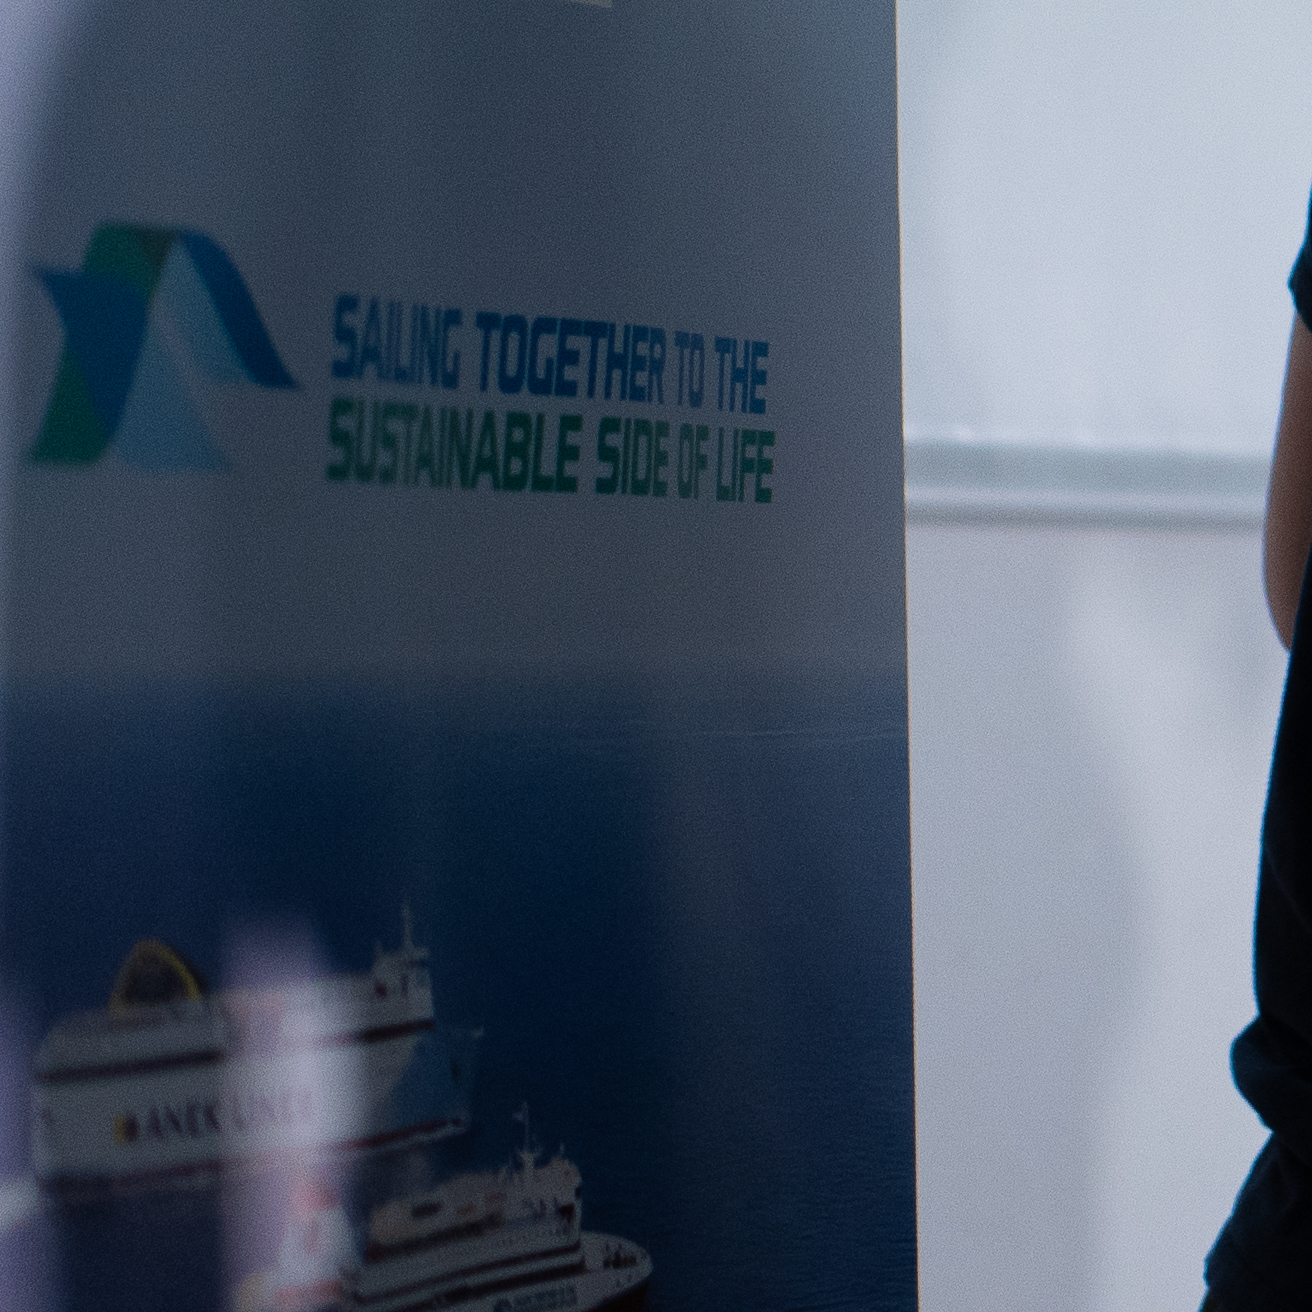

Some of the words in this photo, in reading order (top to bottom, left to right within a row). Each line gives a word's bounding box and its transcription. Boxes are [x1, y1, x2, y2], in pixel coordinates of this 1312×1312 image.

[331, 294, 462, 390] SAILING
[475, 311, 666, 405] TOGETHER
[674, 329, 706, 409] TO
[714, 335, 770, 415] THE
[325, 396, 584, 494] SUSTAINABLE
[595, 414, 669, 499] SIDE
[677, 423, 709, 501] OF
[716, 427, 777, 504] LIFE
